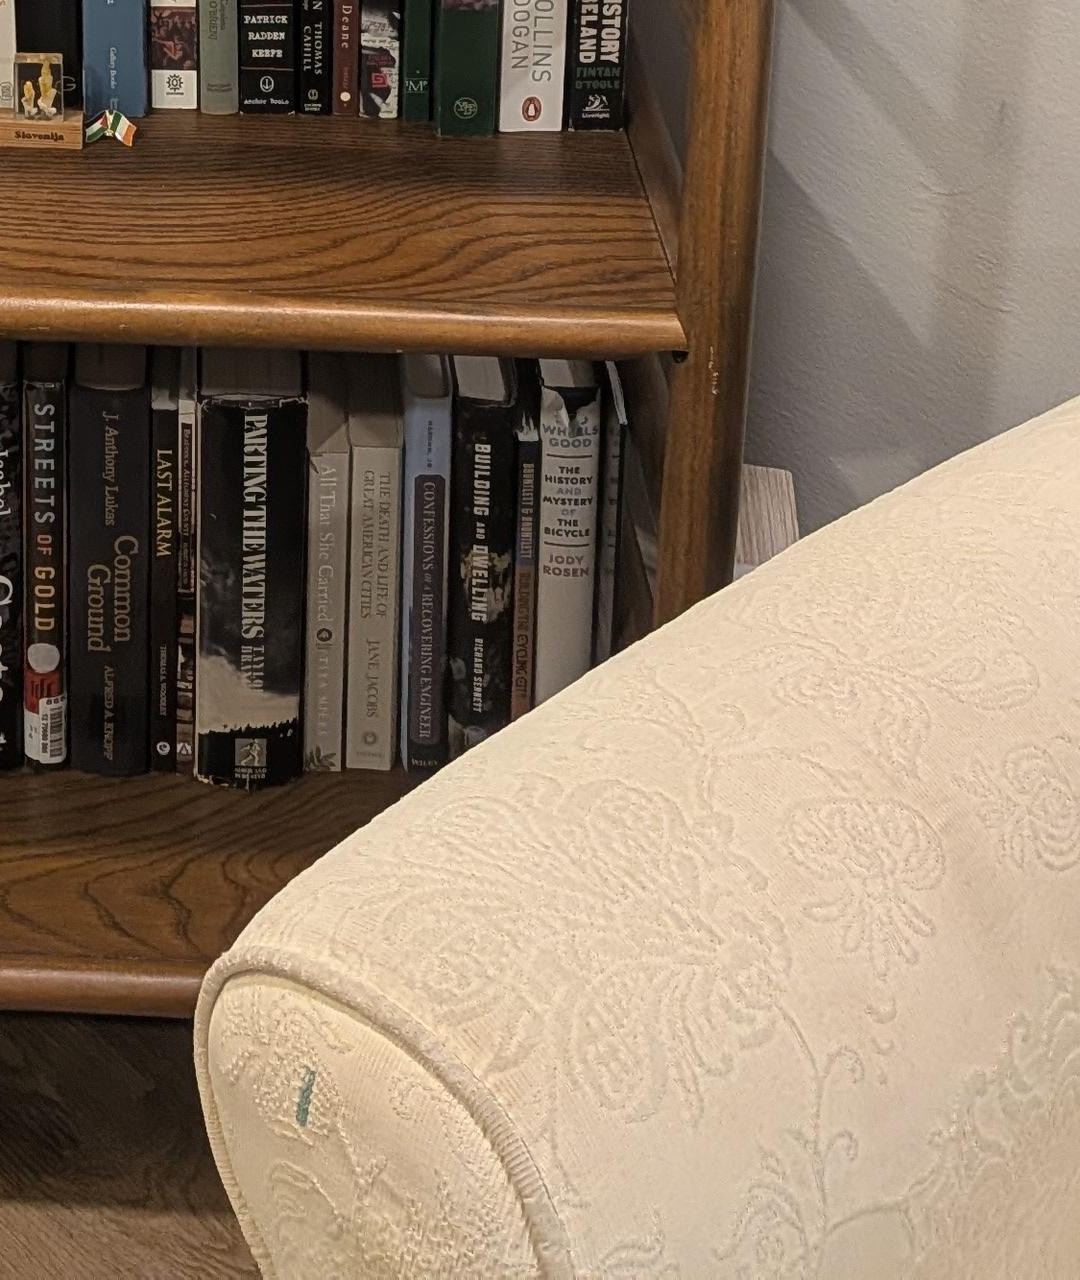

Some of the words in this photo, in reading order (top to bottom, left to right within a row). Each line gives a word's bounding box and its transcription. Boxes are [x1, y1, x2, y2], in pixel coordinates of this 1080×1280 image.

[542, 424, 599, 437] WHLS
[549, 438, 592, 448] GOOD
[34, 402, 56, 524] STREETS
[157, 448, 172, 492] LAST
[558, 465, 580, 475] THE
[545, 474, 593, 486] HISTORY
[557, 487, 582, 495] AND
[542, 497, 593, 506] MYSTERY
[561, 508, 576, 516] OF
[156, 497, 172, 557] ALARM
[557, 518, 579, 528] THE
[544, 527, 590, 538] BICYCLE
[37, 534, 52, 554] OF
[549, 553, 584, 565] JODY
[543, 566, 589, 578] ROSEN
[115, 535, 138, 641] Common
[35, 566, 55, 632] GOLD
[87, 565, 111, 652] Ground
